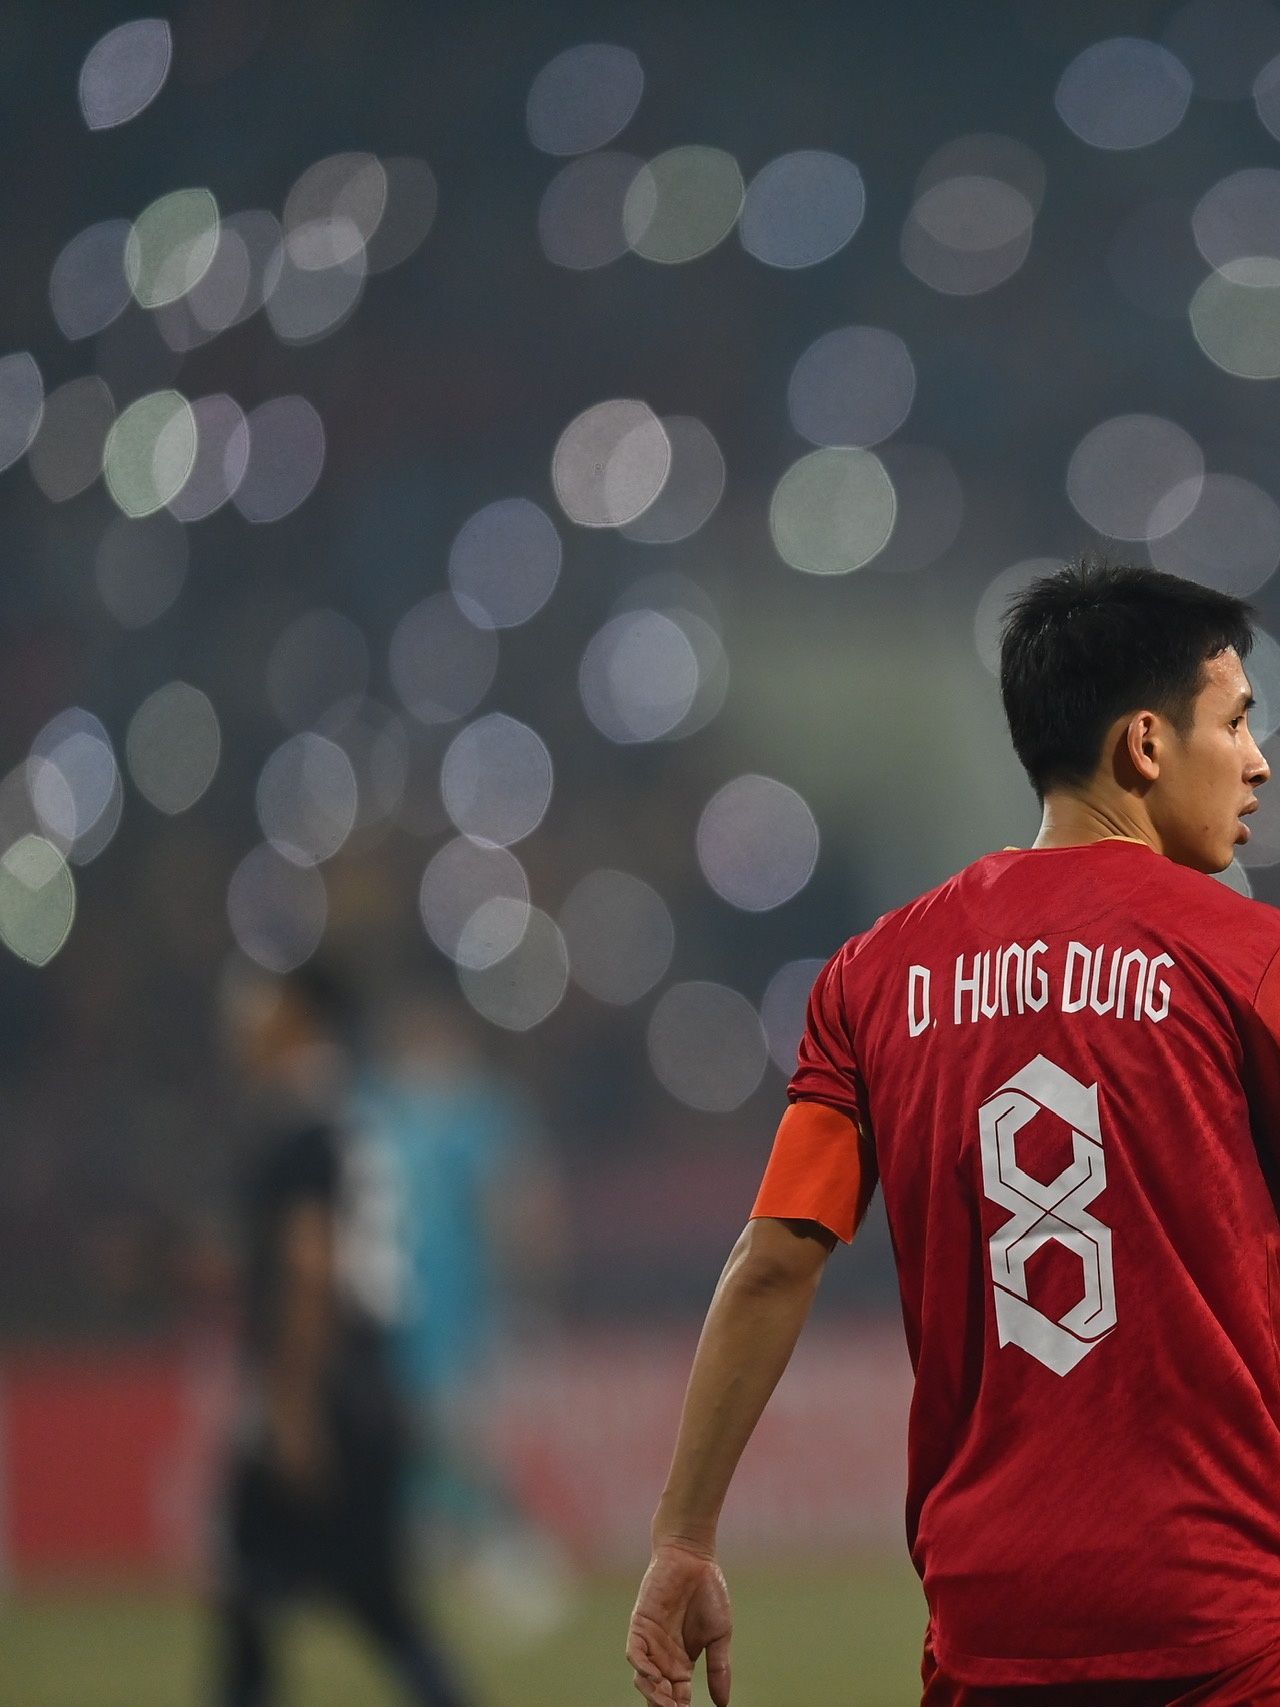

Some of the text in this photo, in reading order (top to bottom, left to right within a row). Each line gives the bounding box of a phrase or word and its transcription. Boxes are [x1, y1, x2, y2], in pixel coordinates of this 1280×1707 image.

[908, 939, 1175, 1037] D. HUNG DUNG
[978, 1053, 1118, 1377] 8
